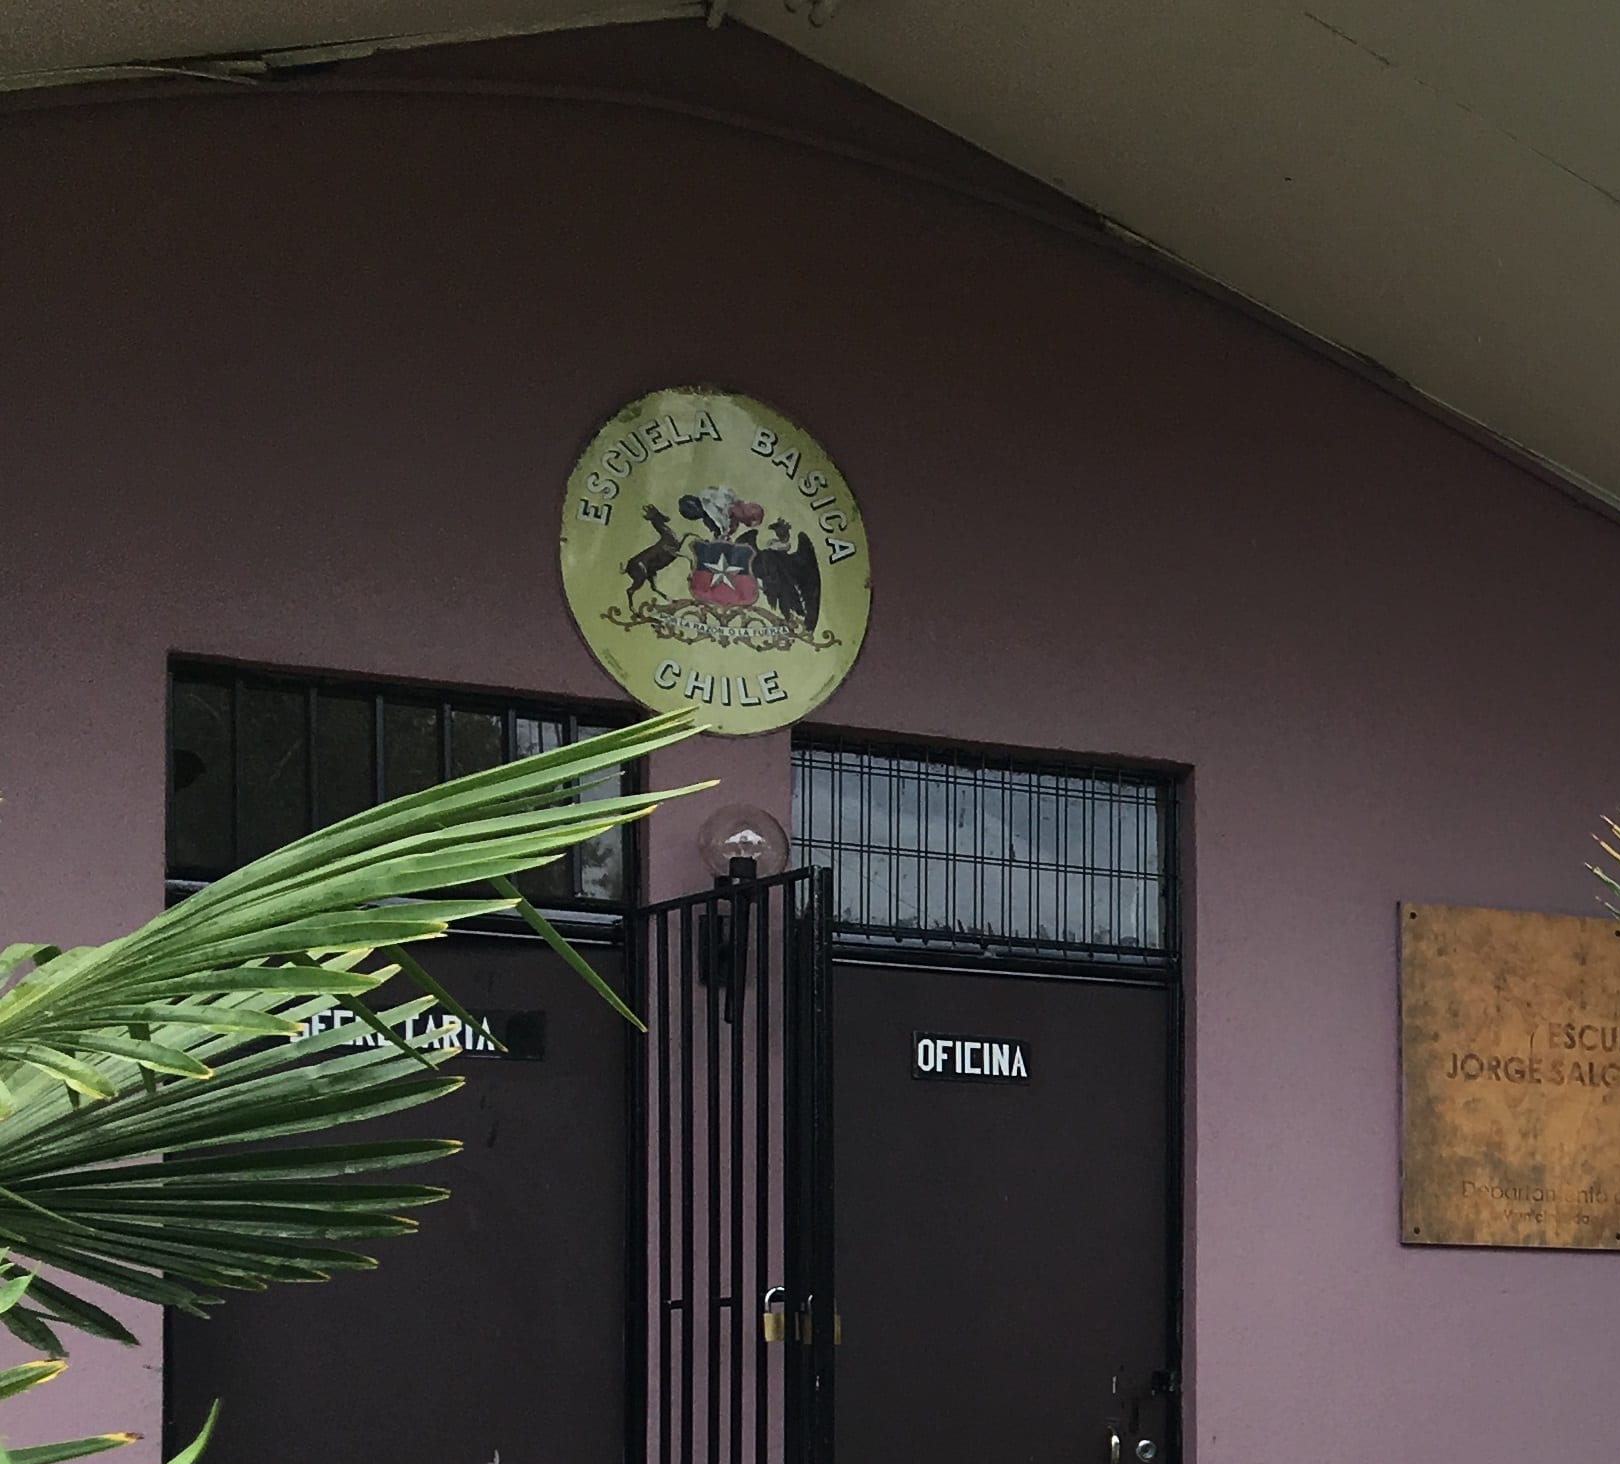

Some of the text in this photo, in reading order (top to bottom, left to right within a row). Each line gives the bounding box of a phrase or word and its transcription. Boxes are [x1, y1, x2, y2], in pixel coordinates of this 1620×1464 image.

[576, 410, 856, 565] ESCUELA BASICA
[654, 659, 788, 706] CHILE
[917, 1038, 1028, 1078] OFICINA
[1446, 1052, 1543, 1085] JORGE
